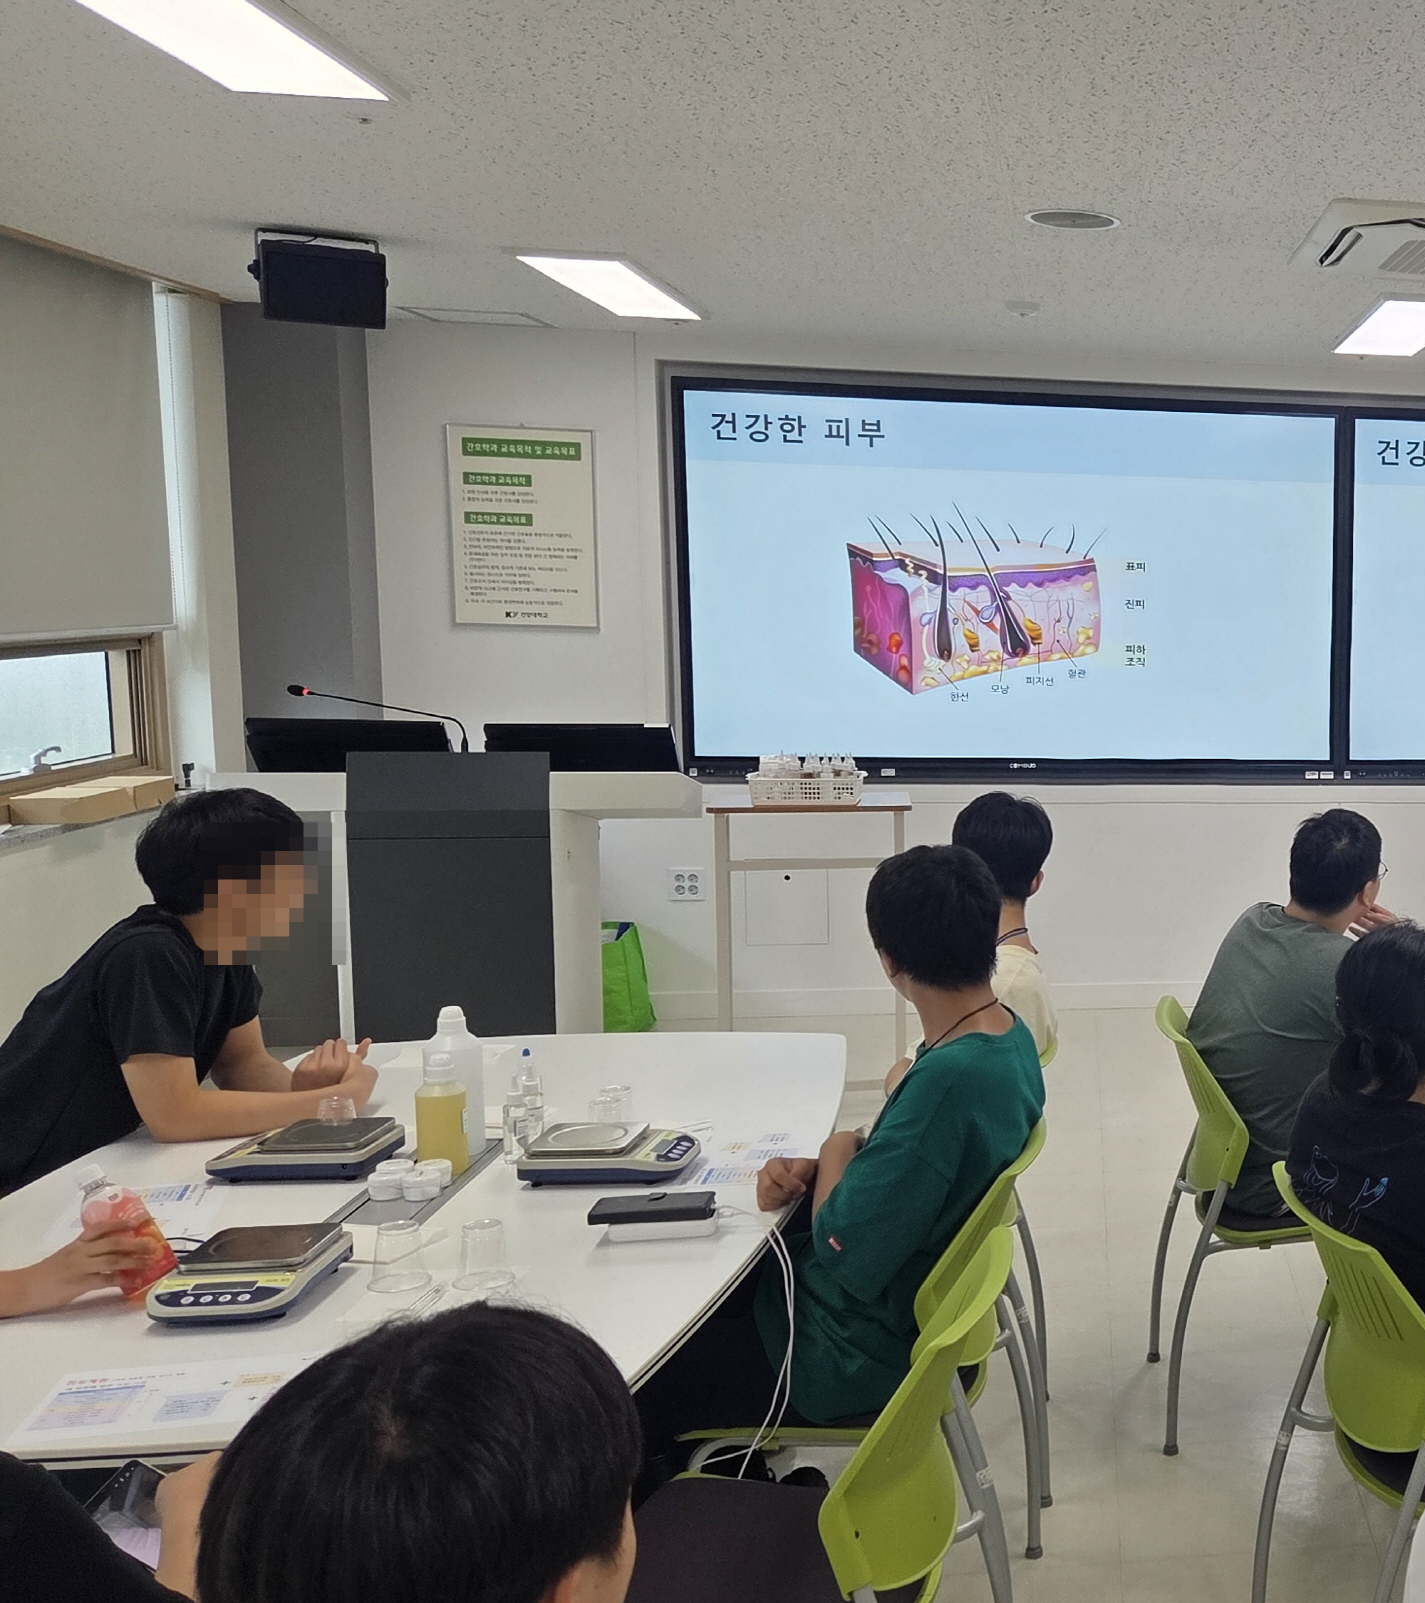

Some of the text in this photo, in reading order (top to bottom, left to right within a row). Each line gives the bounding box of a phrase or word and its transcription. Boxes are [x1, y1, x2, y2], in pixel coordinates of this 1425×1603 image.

[710, 412, 886, 448] 건강한 피부
[466, 442, 577, 456] 간호학과 교육목적 및 교육목표
[468, 474, 496, 485] 간호학과
[469, 513, 498, 524] 간호학과
[1124, 562, 1146, 573] 표피
[1124, 599, 1145, 610] 진피
[1125, 644, 1146, 655] 피하
[1124, 657, 1146, 667] 조직
[1068, 668, 1087, 679] 혈관
[1025, 676, 1055, 687] 피지선
[990, 684, 1010, 695] 모낭
[950, 691, 970, 702] 한선
